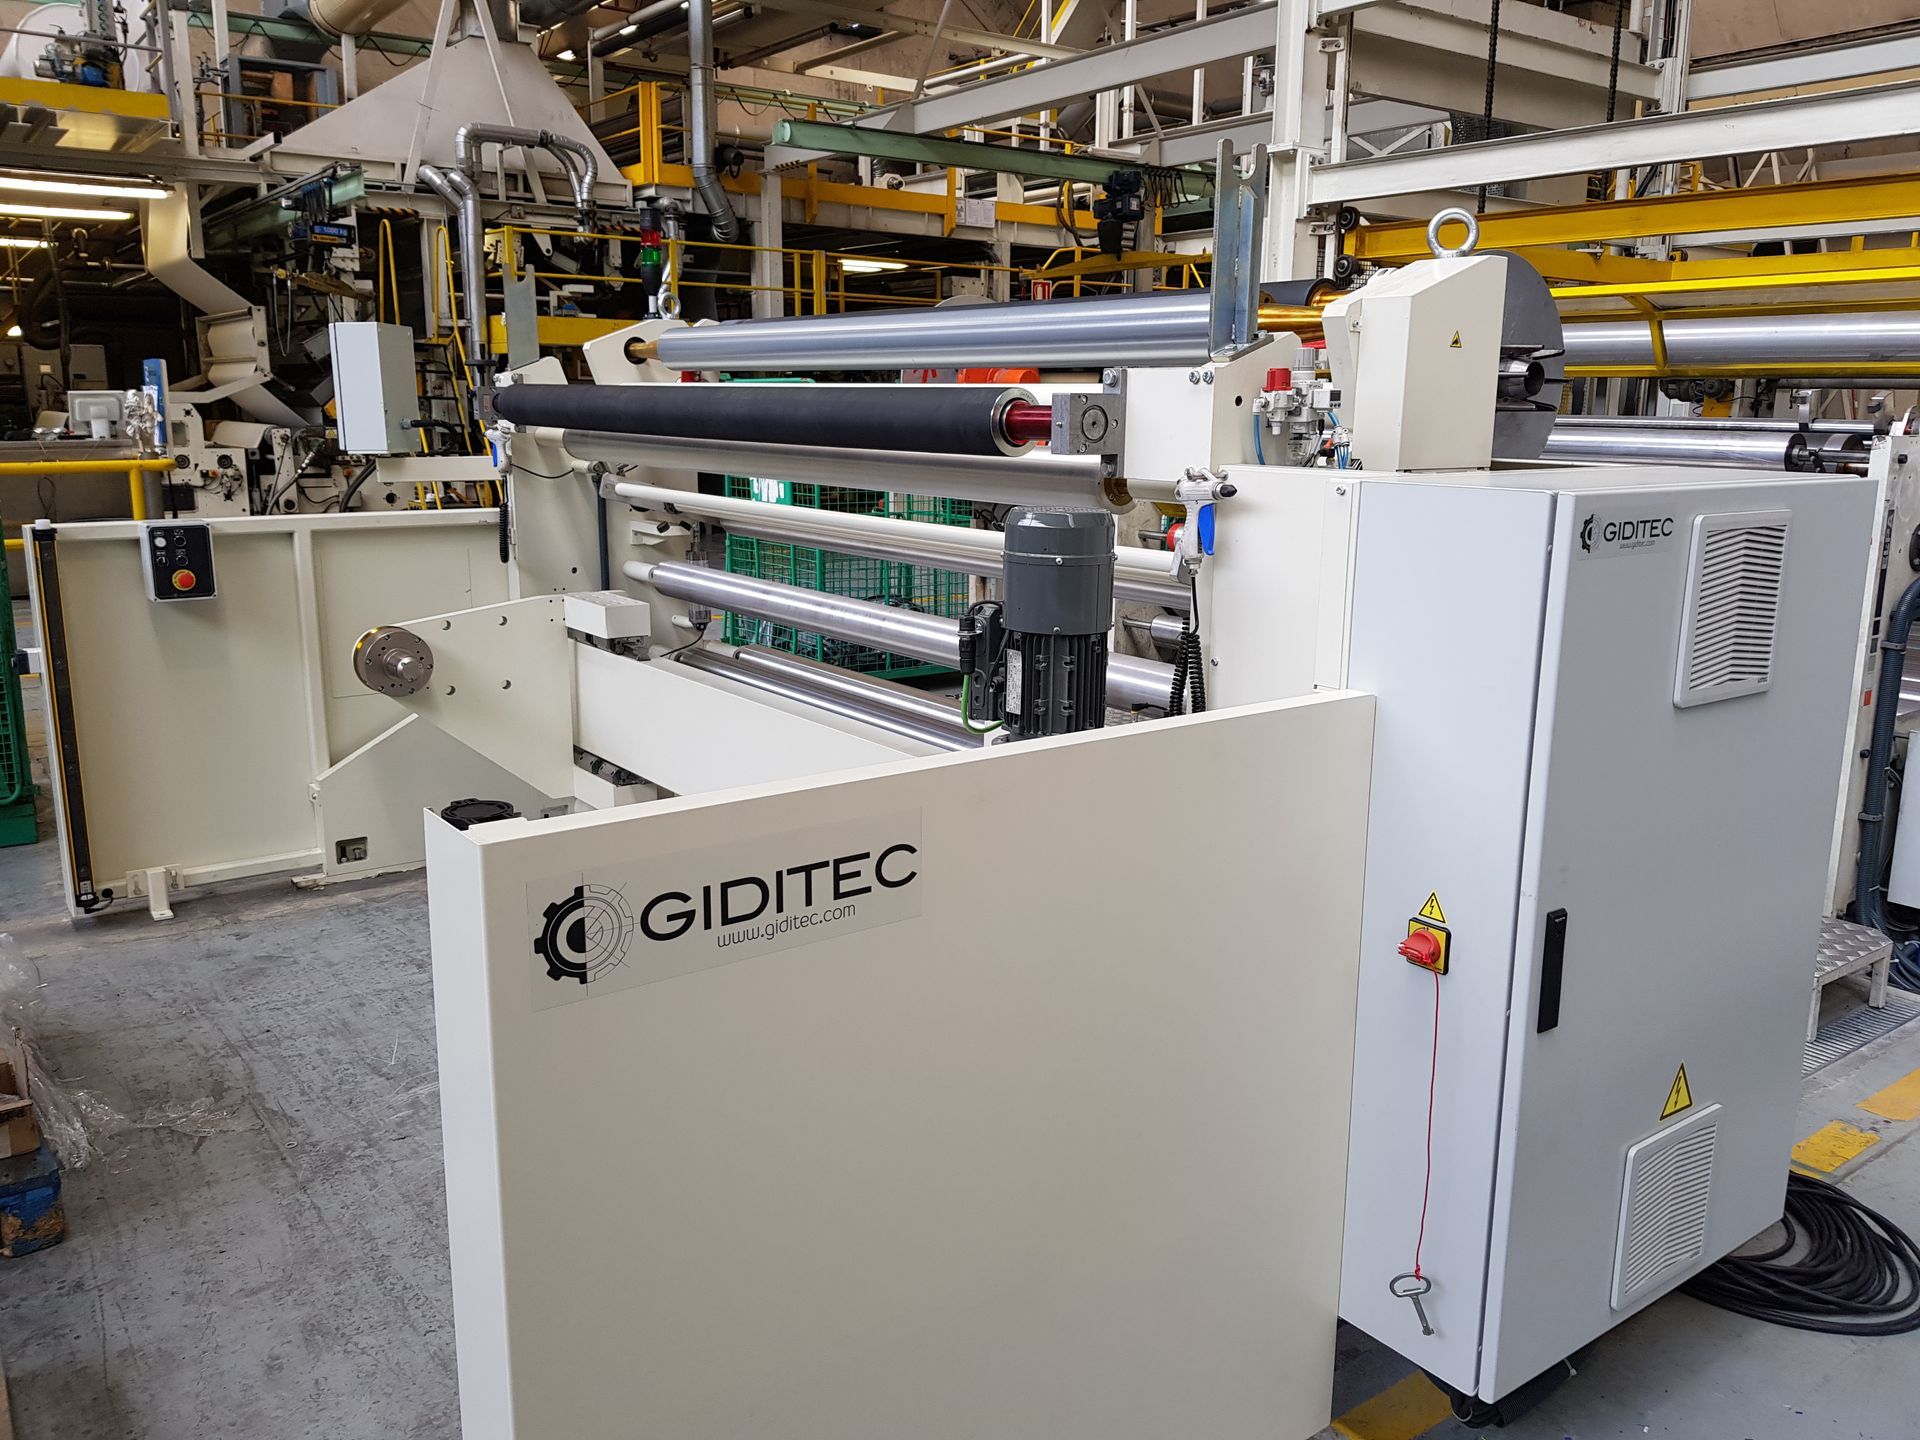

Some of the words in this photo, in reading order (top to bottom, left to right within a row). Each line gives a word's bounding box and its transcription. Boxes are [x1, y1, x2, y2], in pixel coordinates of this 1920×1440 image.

[1603, 517, 1674, 542] GIDITEC
[639, 843, 918, 942] GIDITEC
[716, 903, 857, 948] www.giditec.com
